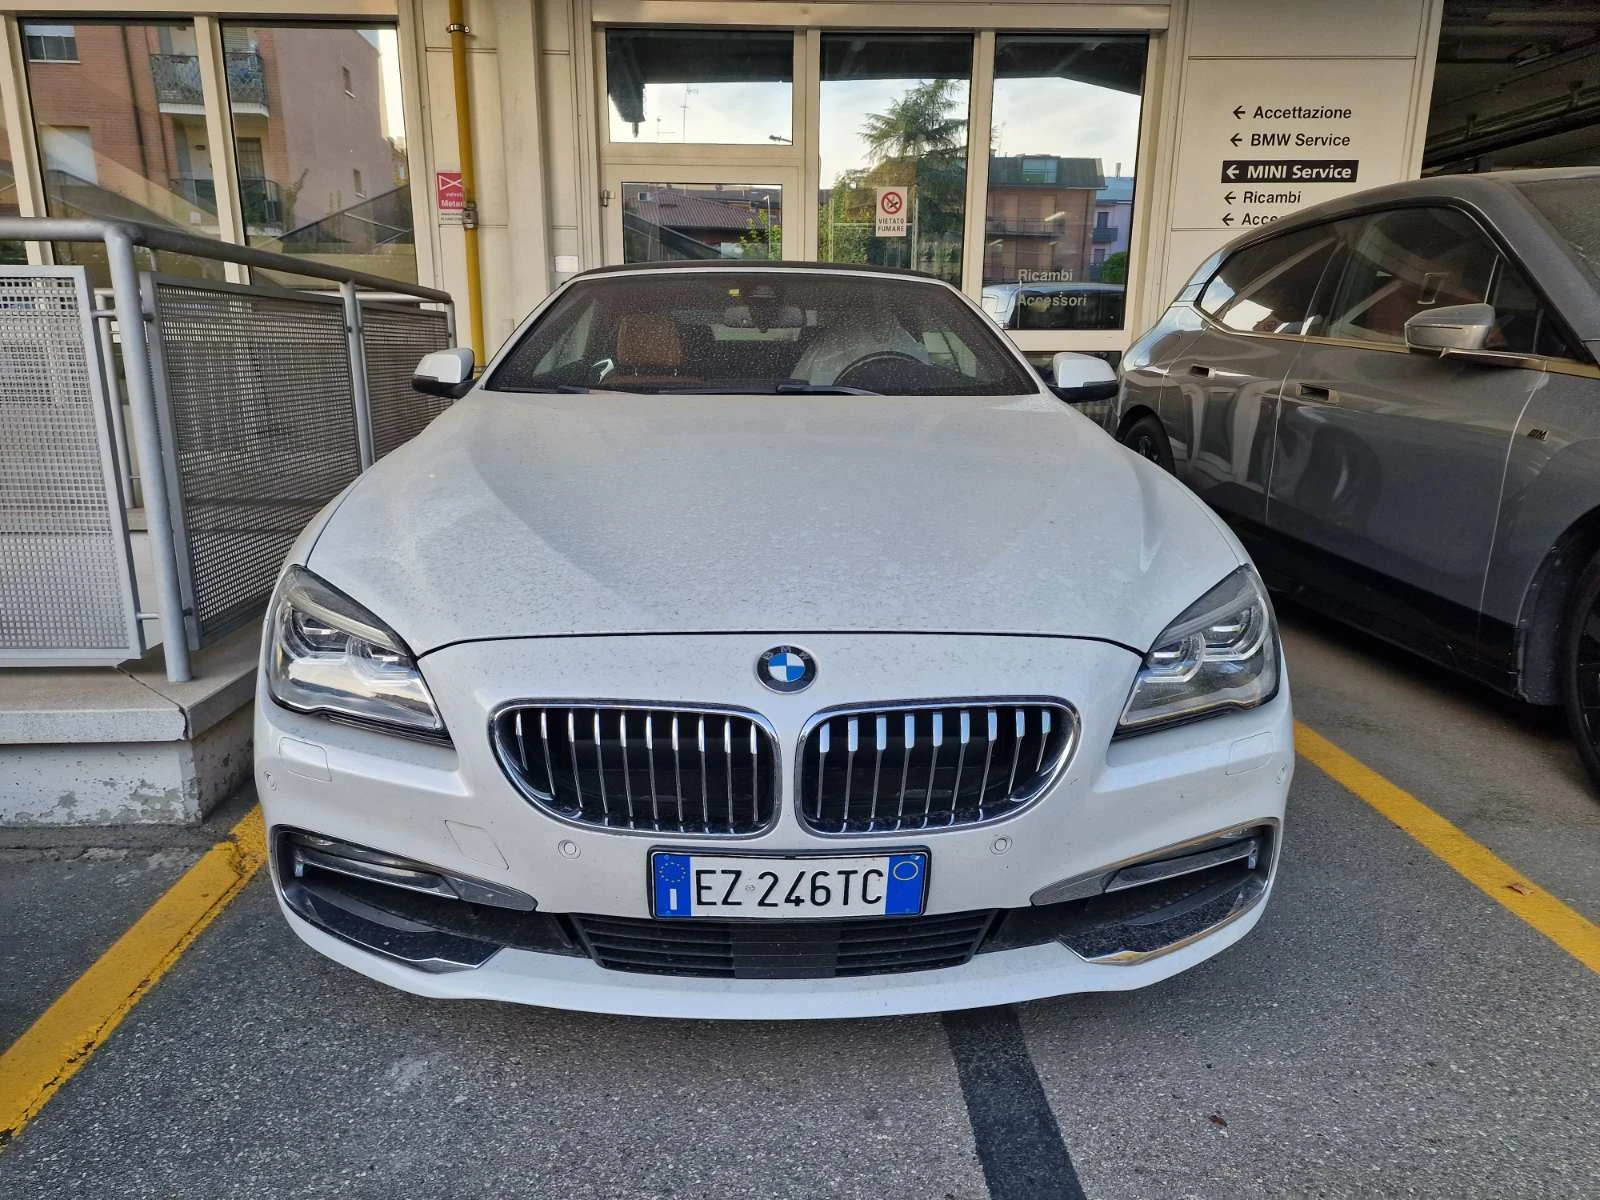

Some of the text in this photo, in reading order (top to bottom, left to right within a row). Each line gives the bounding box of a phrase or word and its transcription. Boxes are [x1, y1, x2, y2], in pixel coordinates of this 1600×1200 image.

[1253, 105, 1352, 119] Accettazione
[1250, 133, 1350, 147] BMW Service
[1247, 165, 1352, 179] MINI Service
[1243, 191, 1301, 204] Ricambi
[1241, 213, 1283, 225] Acce
[1018, 269, 1073, 281] Ricambi
[1018, 294, 1088, 306] Accessori
